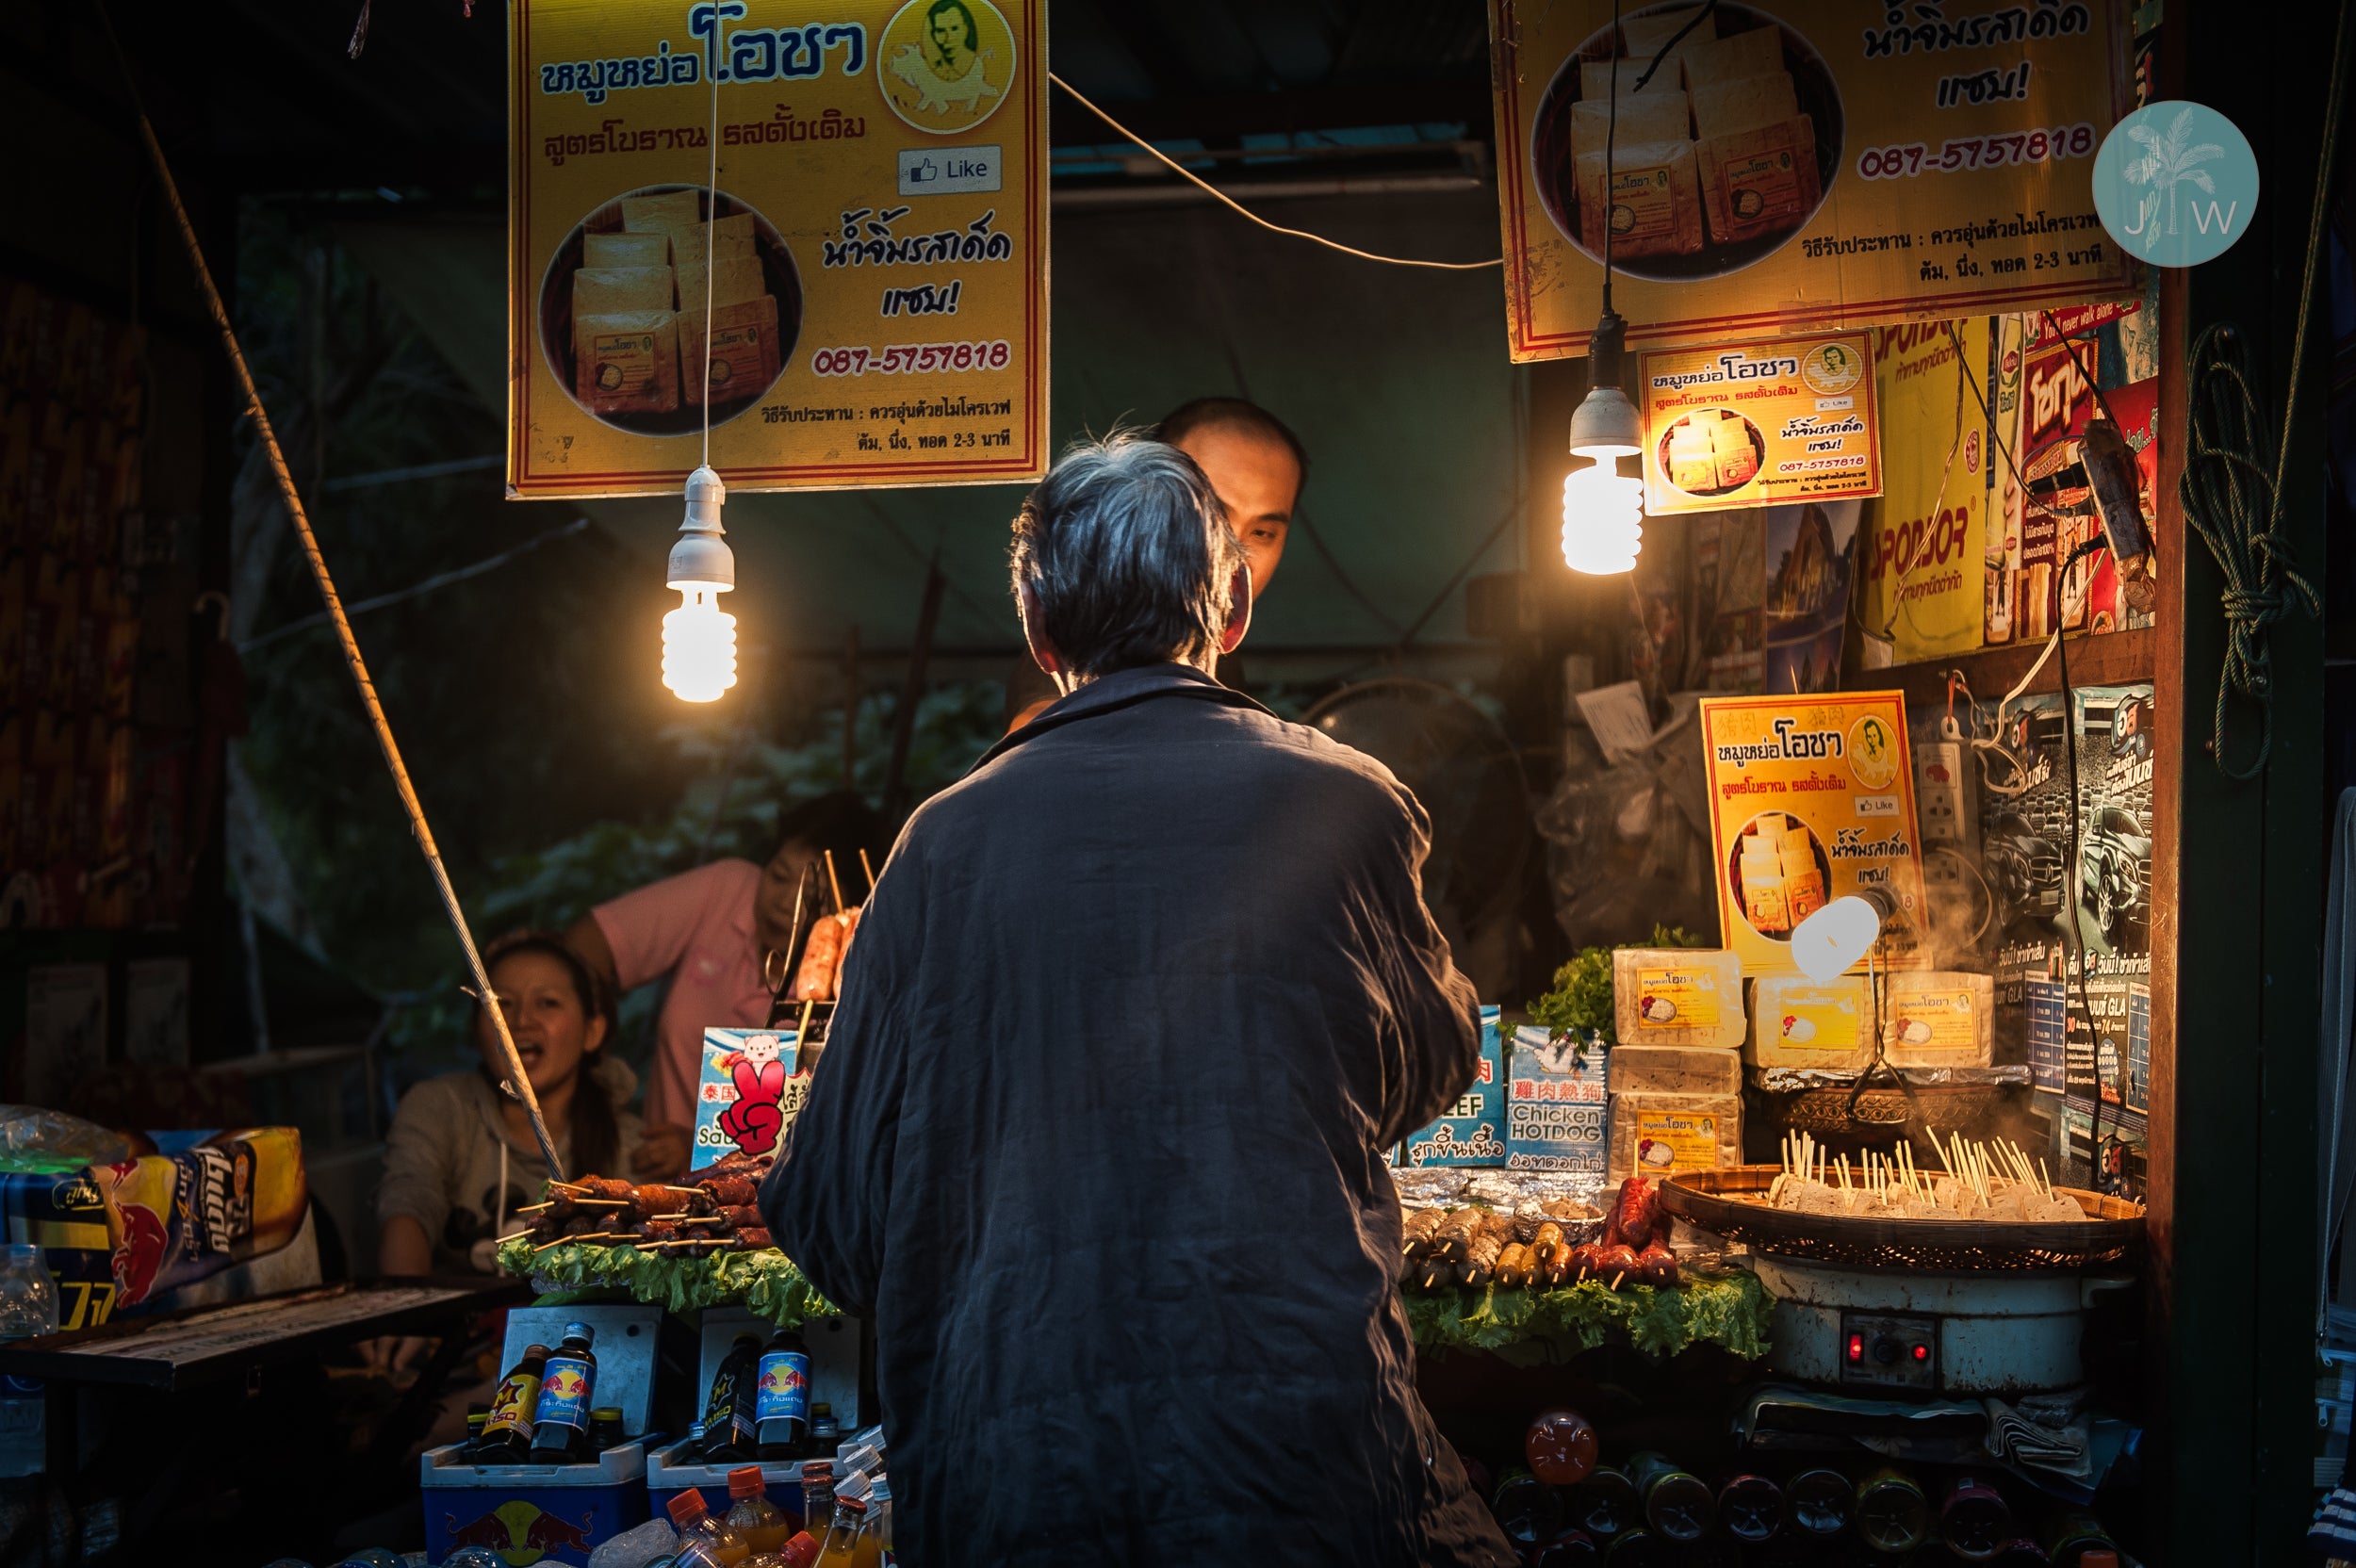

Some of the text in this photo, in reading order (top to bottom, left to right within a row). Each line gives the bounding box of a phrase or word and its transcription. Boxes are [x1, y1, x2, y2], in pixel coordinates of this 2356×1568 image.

[545, 104, 865, 166] สูตรโบราณ รสดั้งเดิม
[1860, 126, 2092, 177] 087-5757818
[947, 160, 988, 178] Like
[824, 207, 1011, 267] น้ำจิ้มรสเด็ด
[1802, 232, 1911, 258] วิธีรับประทาน
[1990, 255, 2026, 274] ทอด
[2034, 251, 2060, 270] 2-3
[2067, 243, 2102, 265] นาที
[882, 281, 961, 316] แซบ!
[2062, 316, 2079, 333] never
[2080, 304, 2095, 325] walk
[2096, 302, 2113, 320] alone
[814, 342, 1009, 374] 087-5757818
[761, 405, 853, 423] วิธีรับประทาน
[870, 397, 1011, 425] ควรอุ่นด้วยไมโครเวฟ
[858, 433, 883, 451] ต้ม,
[919, 433, 947, 448] ทอด
[954, 432, 975, 448] 2-3
[982, 429, 1011, 447] นาที
[1782, 416, 1864, 439] น้ำจิ้มรสเด็ด
[1779, 456, 1864, 472] 087-5757818
[1722, 776, 1787, 800] สูตรโบราณ
[1875, 800, 1893, 810] Like
[1831, 828, 1910, 858] น้ำจิ้มรสเด็ด
[2107, 997, 2127, 1018] GLA
[1513, 1081, 1602, 1102] 雞肉熱狗
[1513, 1105, 1600, 1124] Chicken
[1511, 1124, 1601, 1141] HOTDOG
